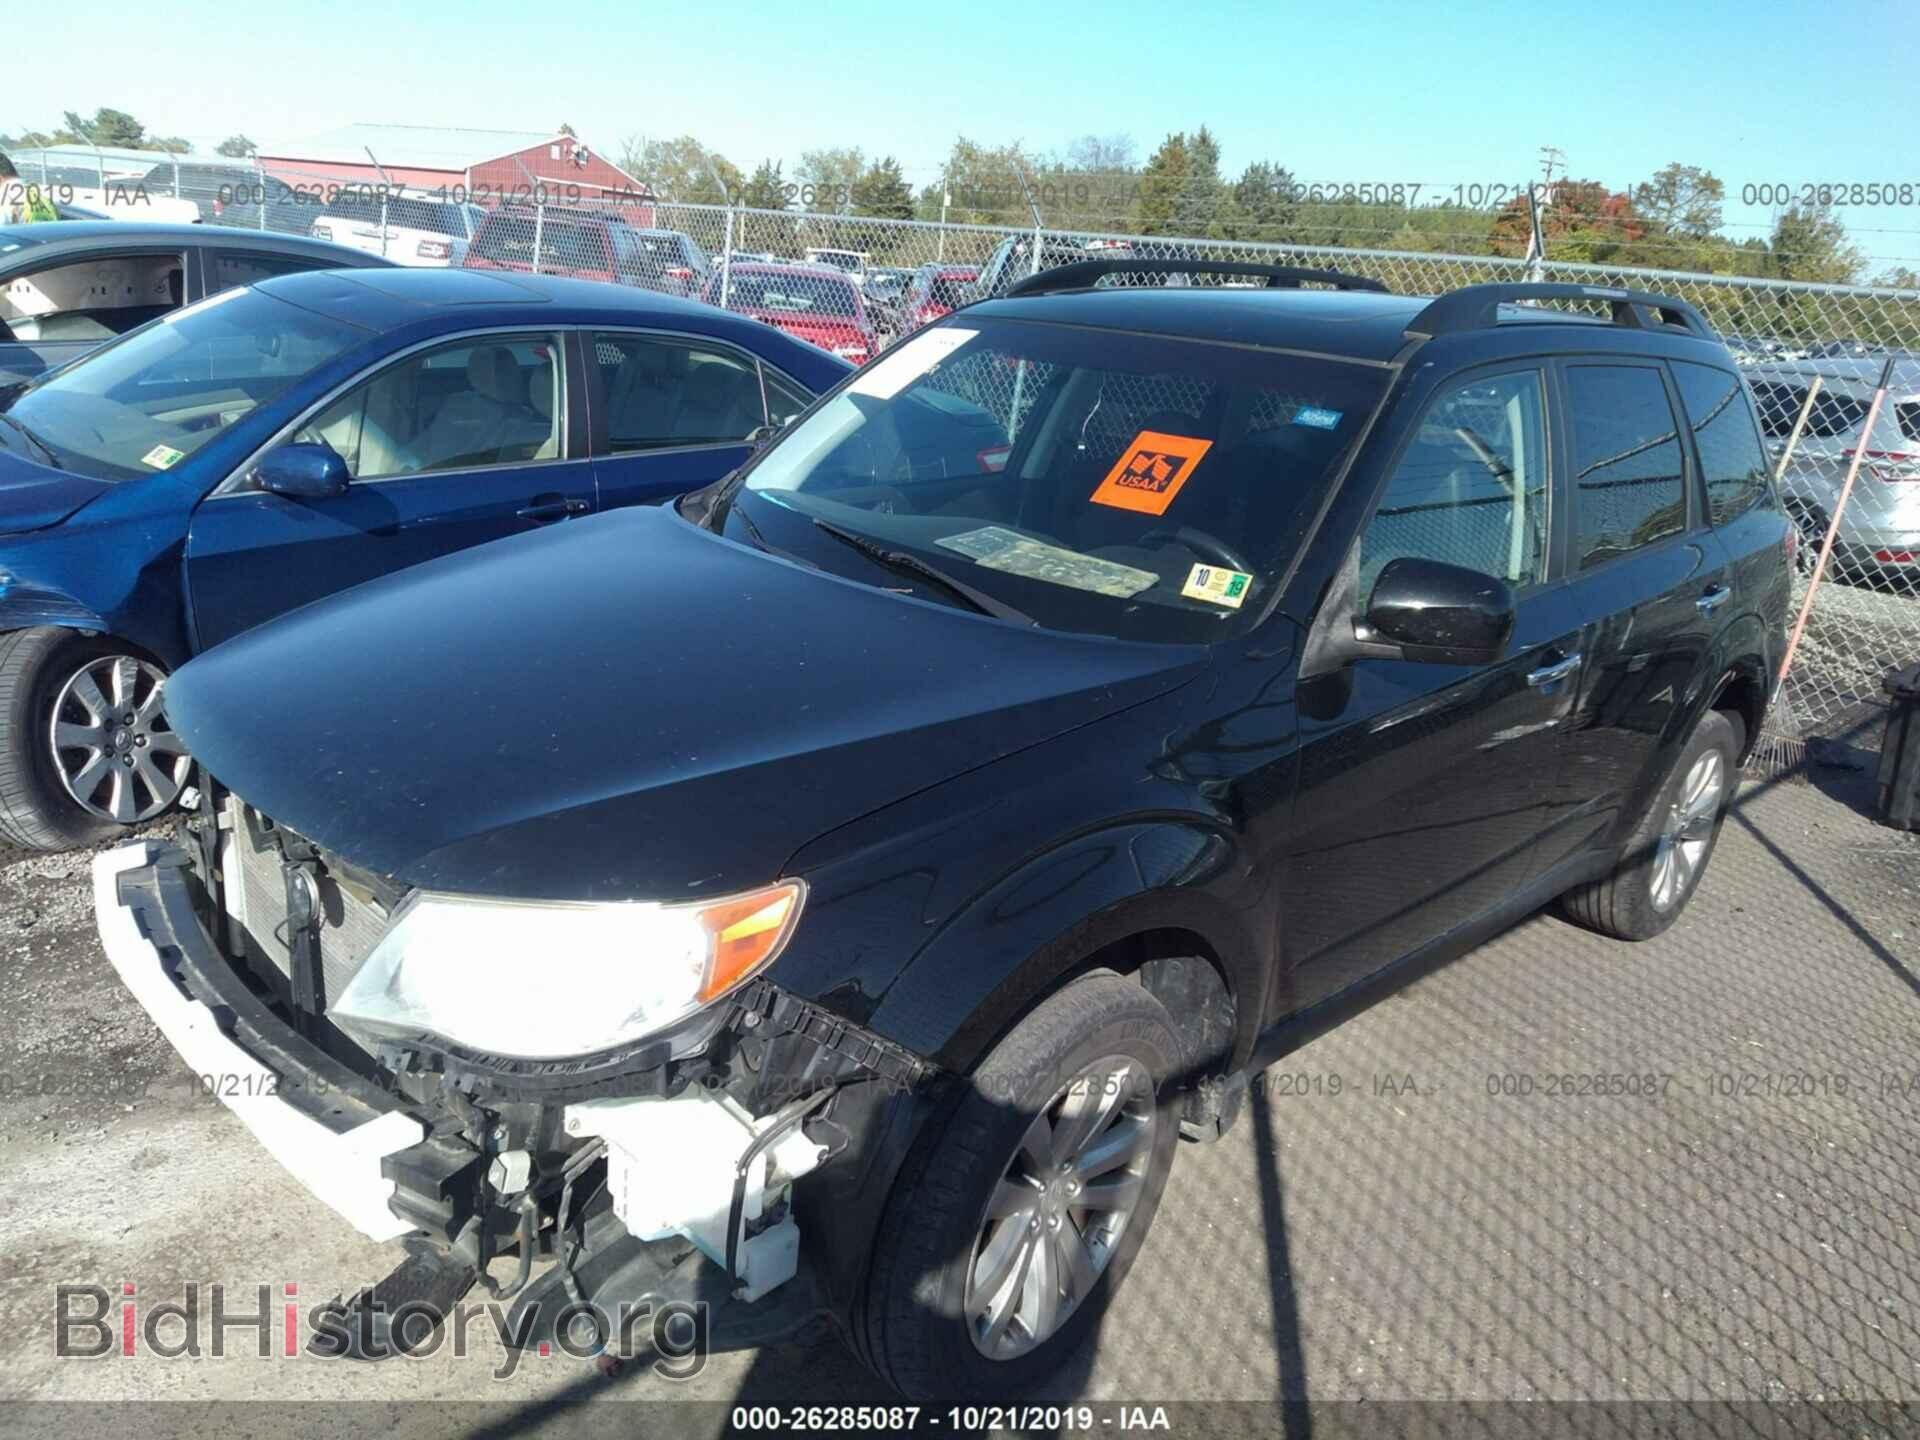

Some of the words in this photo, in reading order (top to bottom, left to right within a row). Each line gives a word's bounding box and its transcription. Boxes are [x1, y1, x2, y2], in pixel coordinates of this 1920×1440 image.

[1118, 474, 1159, 491] USAA
[1195, 568, 1210, 586] 10
[1229, 579, 1244, 597] 19
